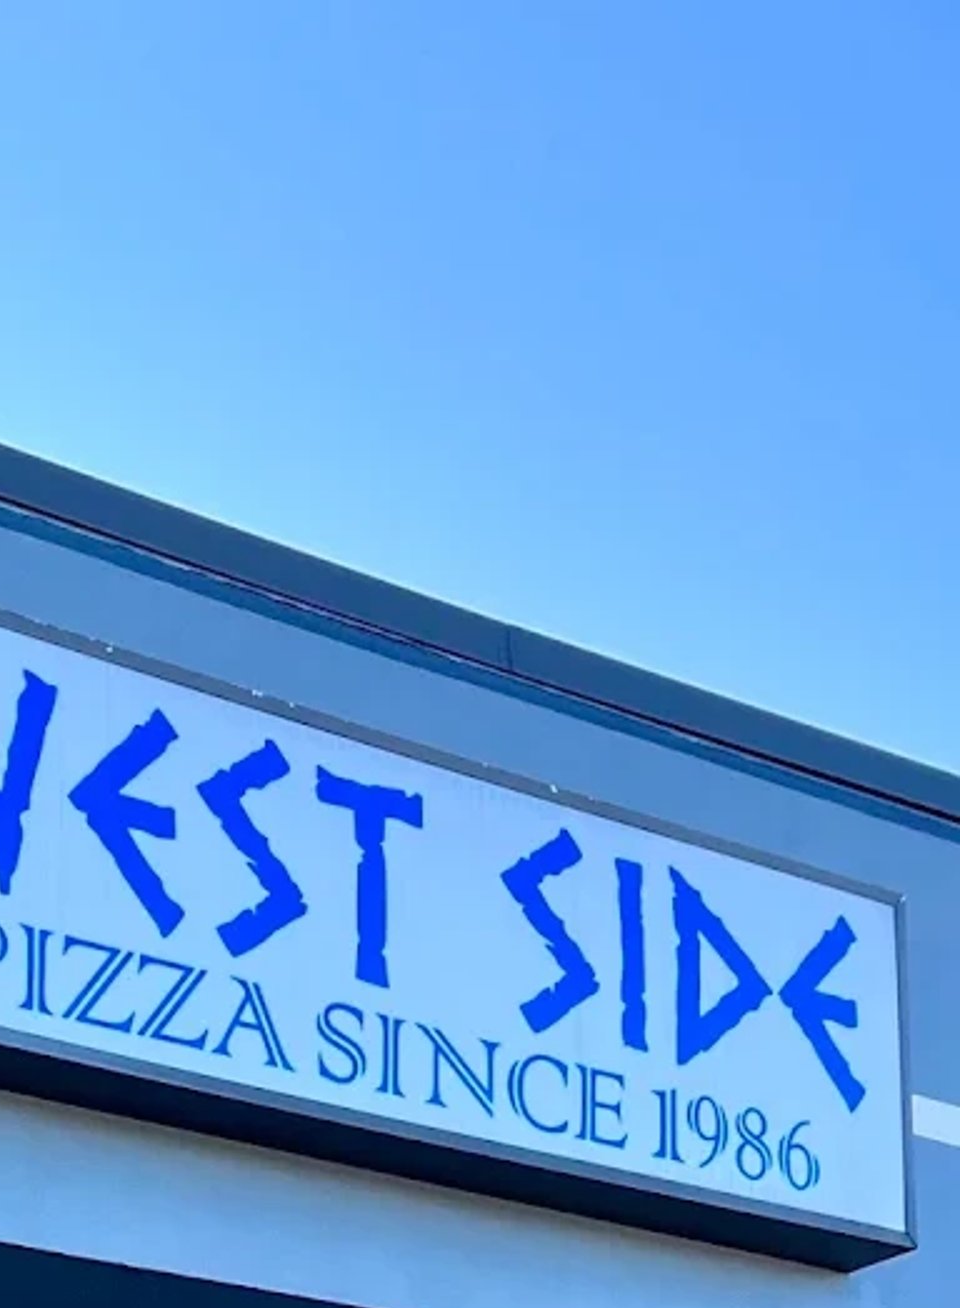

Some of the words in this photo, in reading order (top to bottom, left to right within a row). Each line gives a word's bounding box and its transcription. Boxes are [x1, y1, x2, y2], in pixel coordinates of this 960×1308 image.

[499, 828, 867, 1114] SIDE
[315, 1002, 629, 1150] SINCE
[651, 1088, 822, 1192] 1986
